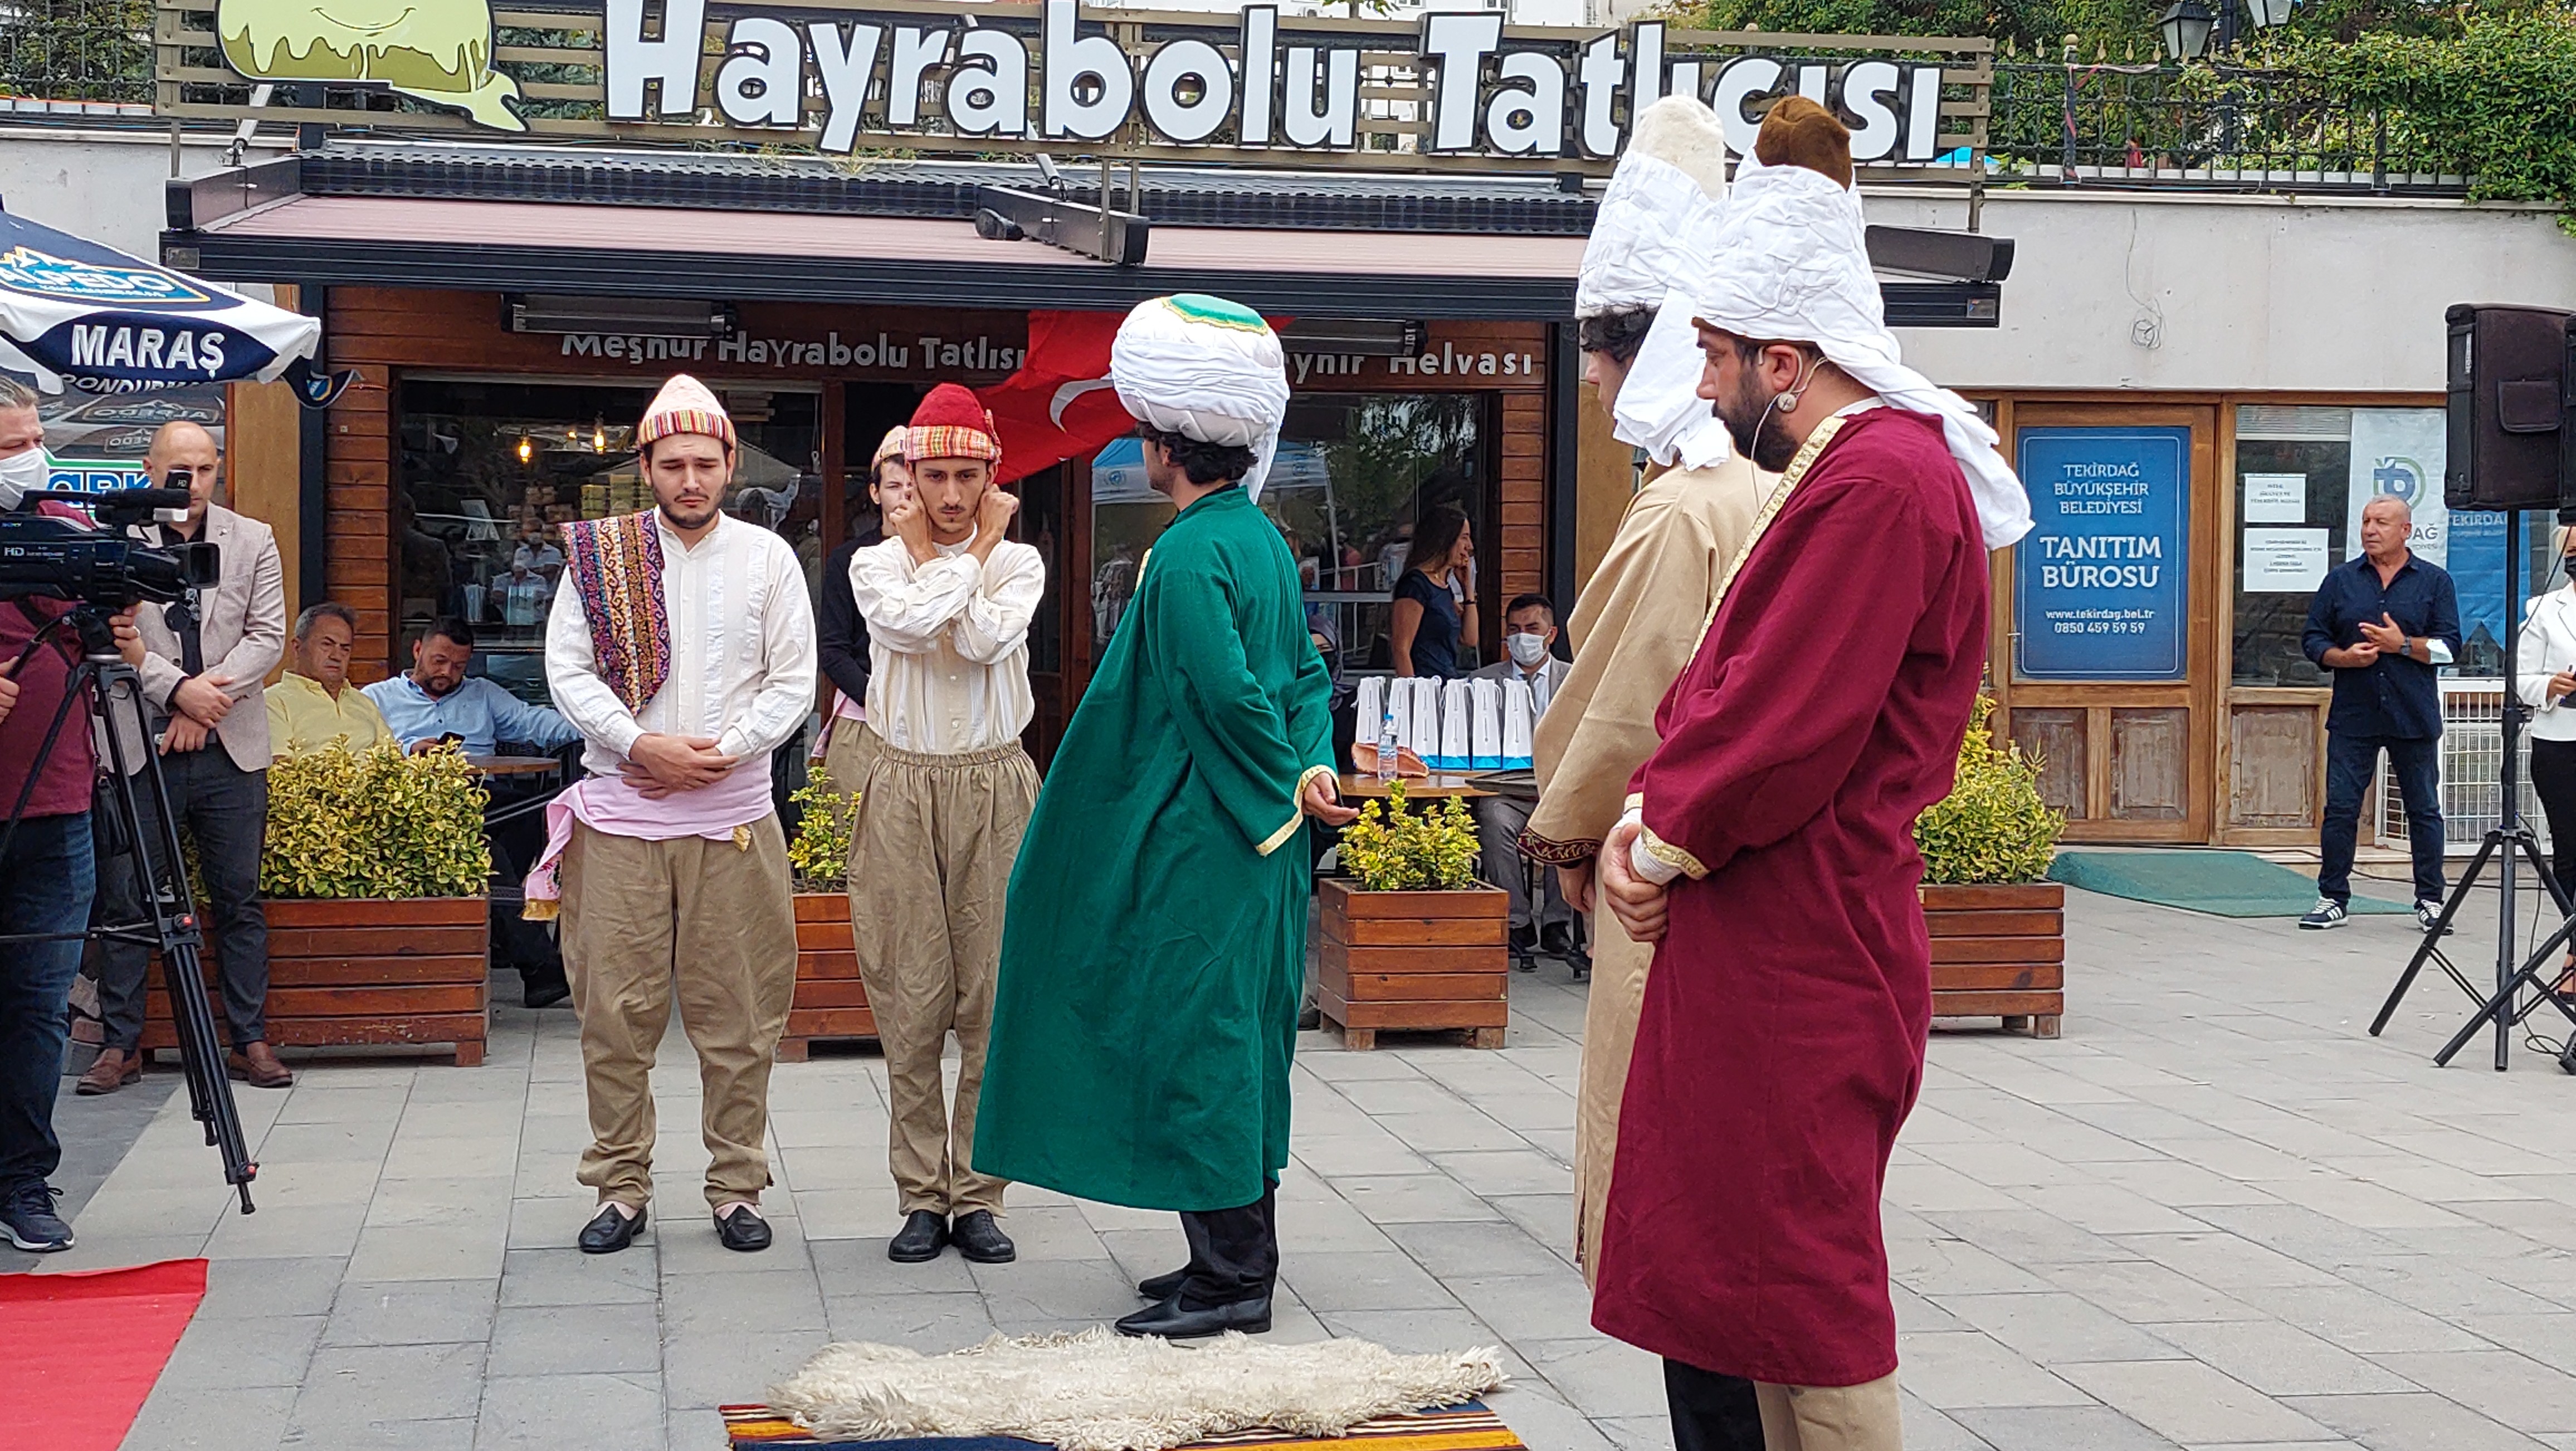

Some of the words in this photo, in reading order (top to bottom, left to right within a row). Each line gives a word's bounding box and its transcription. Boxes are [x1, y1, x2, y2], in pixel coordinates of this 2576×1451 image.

[603, 0, 1360, 154] Hayrabolu
[71, 324, 225, 380] MARAŞ
[561, 334, 708, 364] Meşnur
[1389, 342, 1532, 375] Helvası
[2063, 461, 2140, 478] TEKİRDAĞ
[2055, 480, 2149, 499] BÜYÜKŞEHİR
[2060, 498, 2143, 514] BELEDİYESİ
[2450, 513, 2507, 527] EKİRDA
[4, 547, 25, 556] HD
[2039, 535, 2162, 559] TANITIM
[2041, 561, 2160, 588] BÜROSU
[2045, 608, 2156, 621] www.tekirdag.bel.tr
[2054, 622, 2084, 634] 0850
[2087, 622, 2109, 634] 459
[2112, 622, 2128, 634] 59
[2130, 622, 2145, 634] 59
